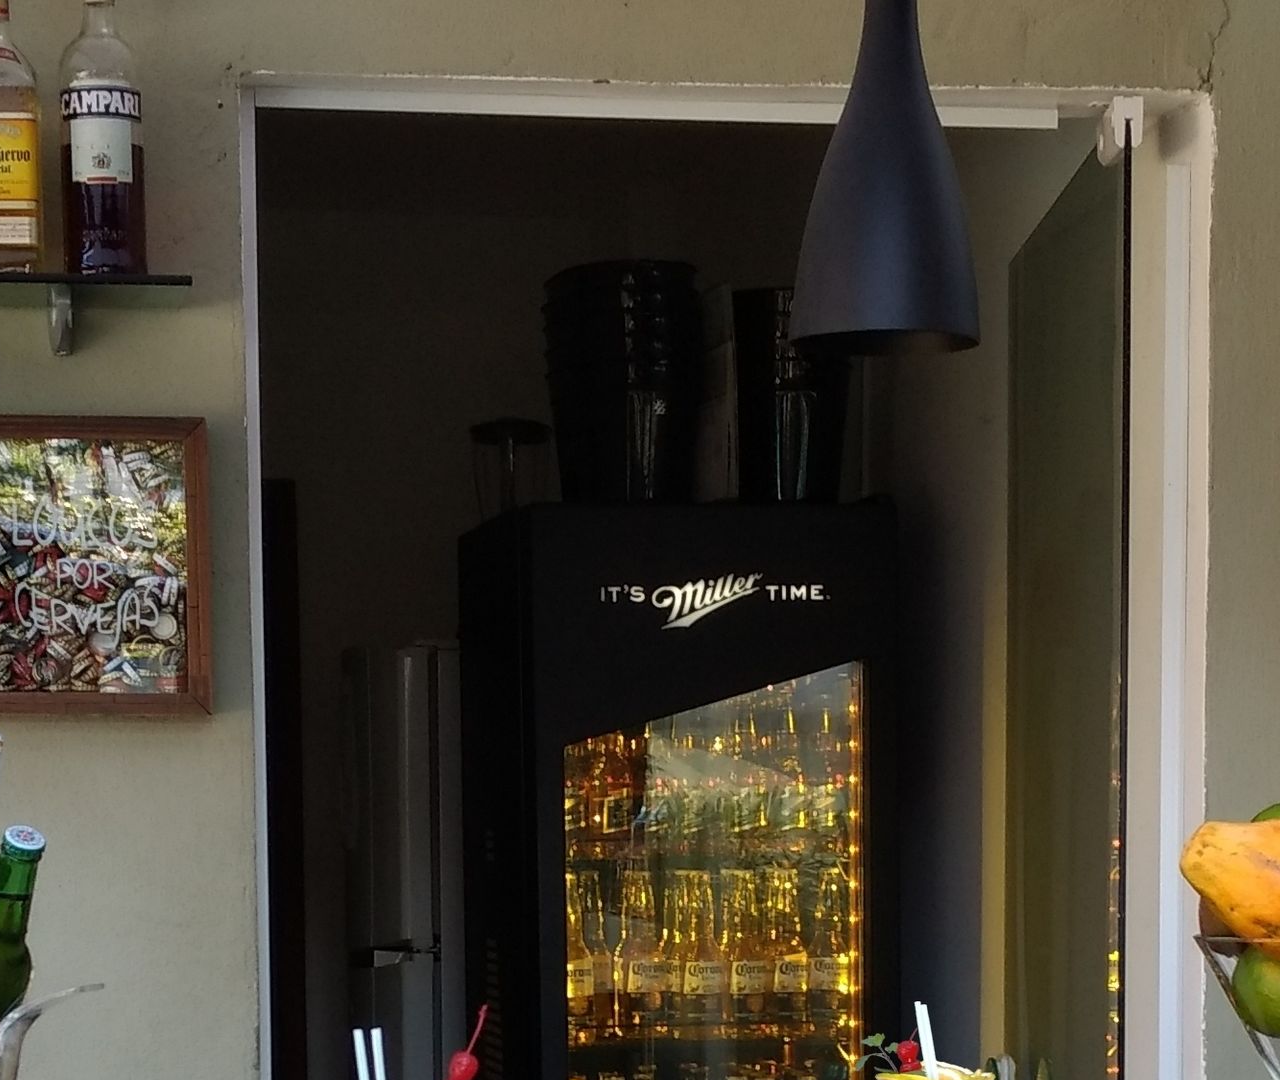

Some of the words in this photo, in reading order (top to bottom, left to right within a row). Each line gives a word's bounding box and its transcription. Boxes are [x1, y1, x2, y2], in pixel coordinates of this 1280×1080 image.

[61, 90, 140, 117] CAMPARI
[56, 557, 115, 589] POR
[14, 581, 159, 650] CERVEJAS
[600, 585, 646, 603] IT'S
[651, 572, 763, 630] Miller
